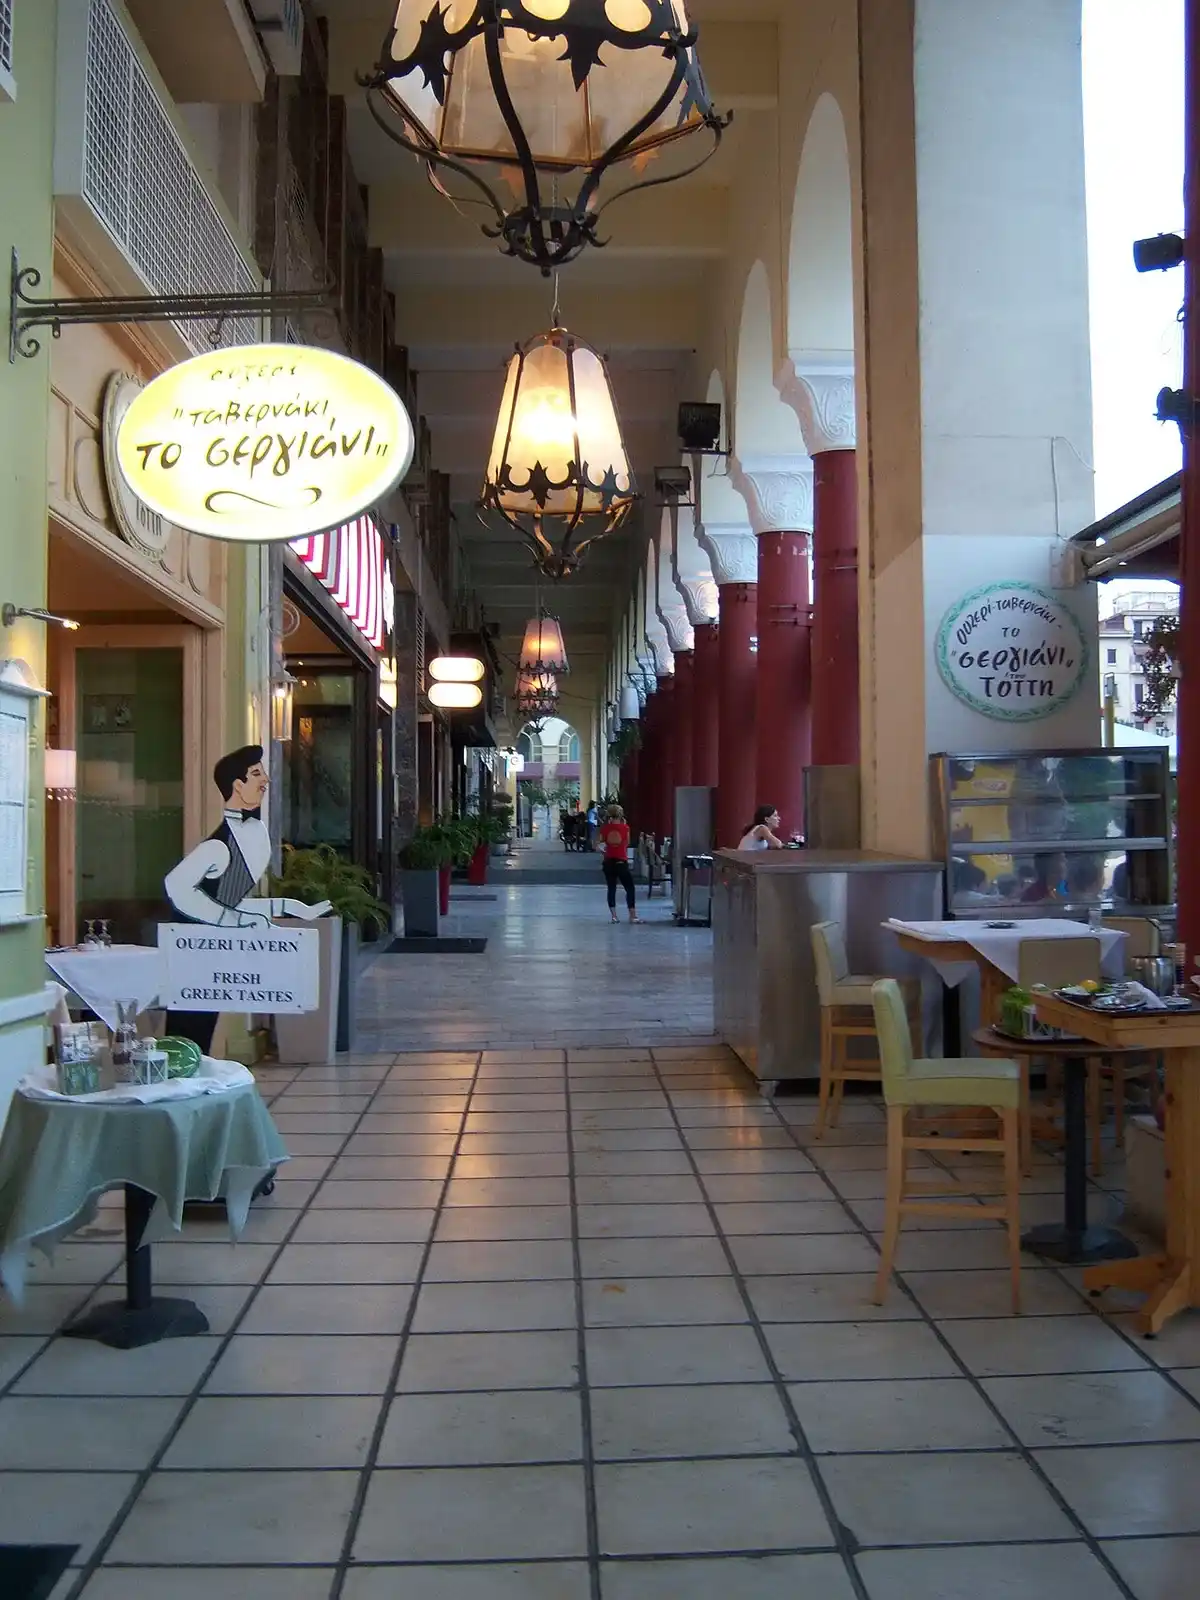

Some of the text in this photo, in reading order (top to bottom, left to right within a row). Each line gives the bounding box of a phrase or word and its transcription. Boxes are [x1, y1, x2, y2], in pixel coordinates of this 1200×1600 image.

[175, 937, 299, 953] OUZERI TAVERN
[213, 971, 261, 985] FRESH
[180, 987, 293, 1003] GREEK TASTES
